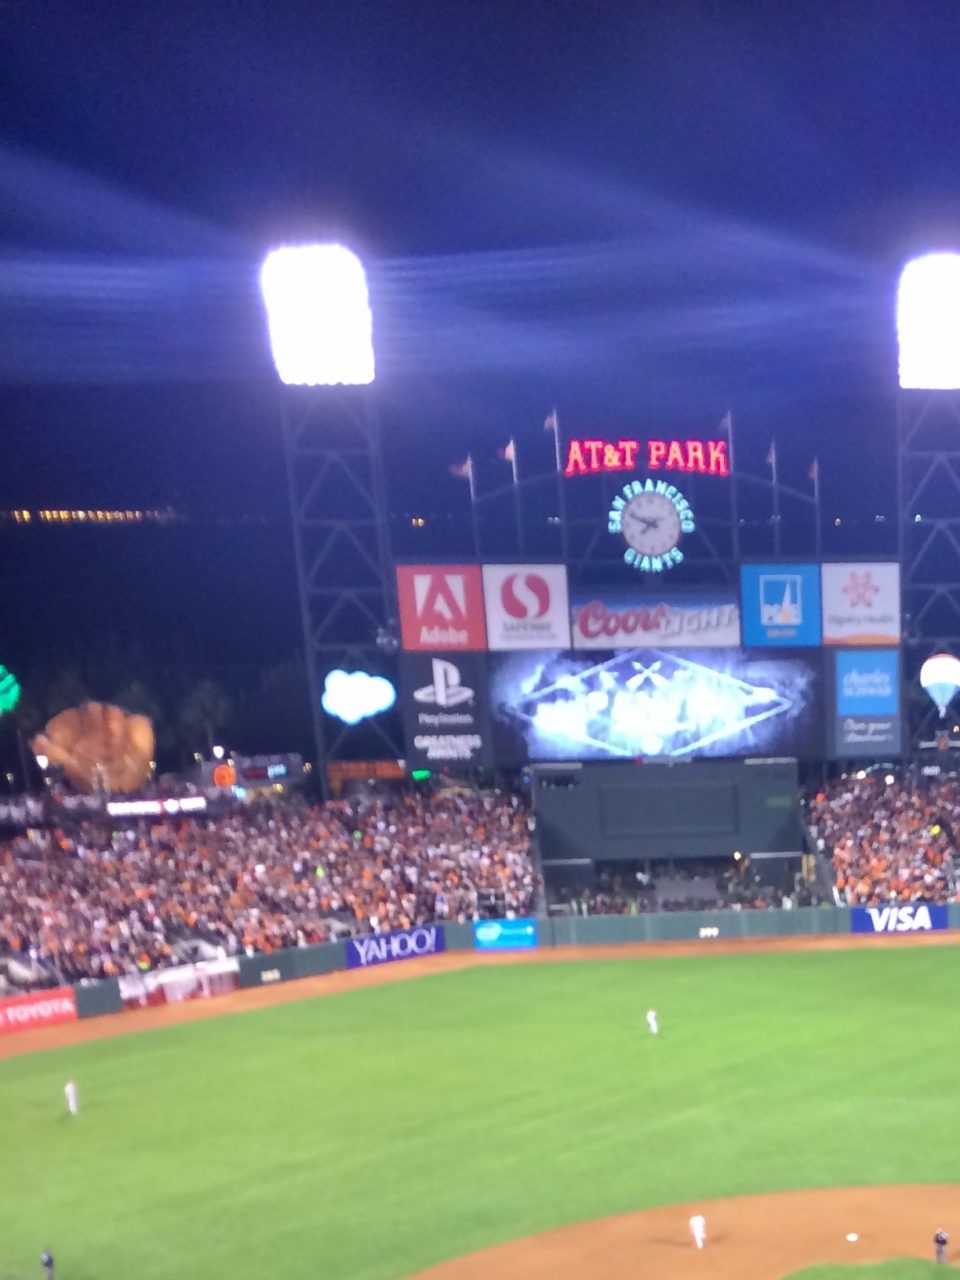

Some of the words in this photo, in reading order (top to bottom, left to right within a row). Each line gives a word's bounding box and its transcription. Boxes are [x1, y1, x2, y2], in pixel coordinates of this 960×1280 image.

[565, 440, 638, 477] AT&T
[648, 440, 729, 477] PARK
[622, 478, 696, 533] FRANCISCO
[624, 546, 684, 573] GIANTS
[420, 625, 469, 645] Adobe
[865, 905, 932, 932] VISA
[353, 927, 436, 965] YAHOO!
[8, 998, 73, 1024] TOYOTA
